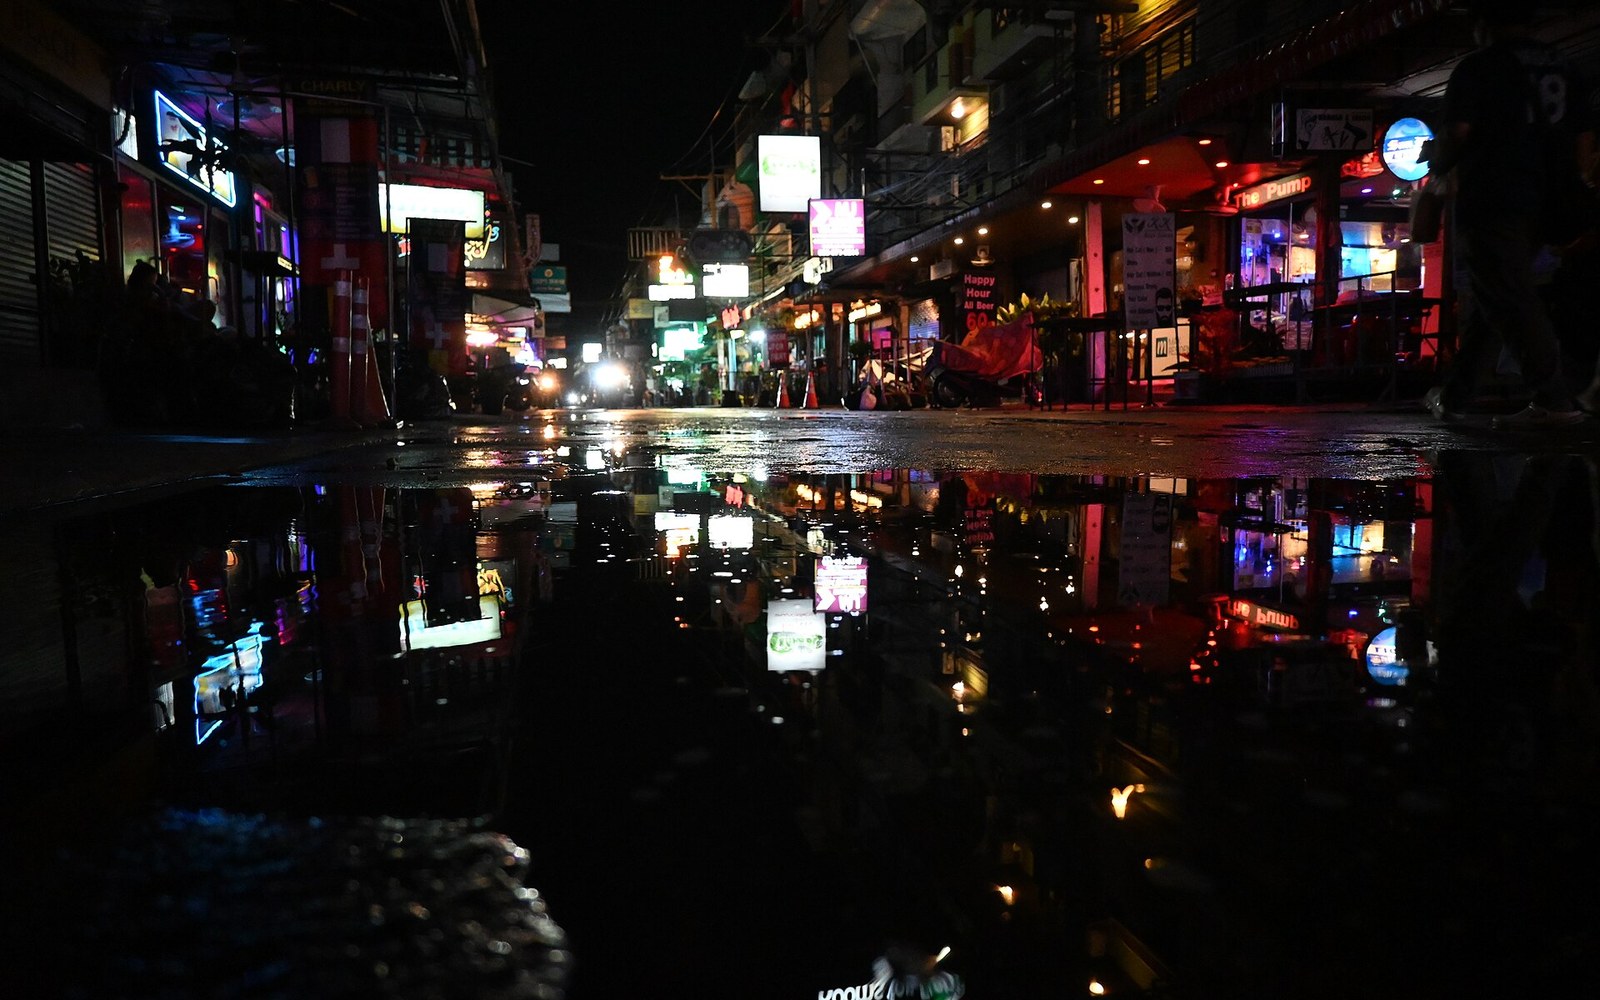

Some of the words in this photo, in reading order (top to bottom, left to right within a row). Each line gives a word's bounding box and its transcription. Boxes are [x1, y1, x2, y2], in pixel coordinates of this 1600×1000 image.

[300, 80, 366, 92] CHARLY
[1234, 190, 1260, 209] The
[1266, 176, 1312, 200] Pump
[964, 274, 995, 286] Happy
[966, 288, 991, 298] Hour
[964, 301, 974, 310] All
[976, 301, 994, 310] Beer
